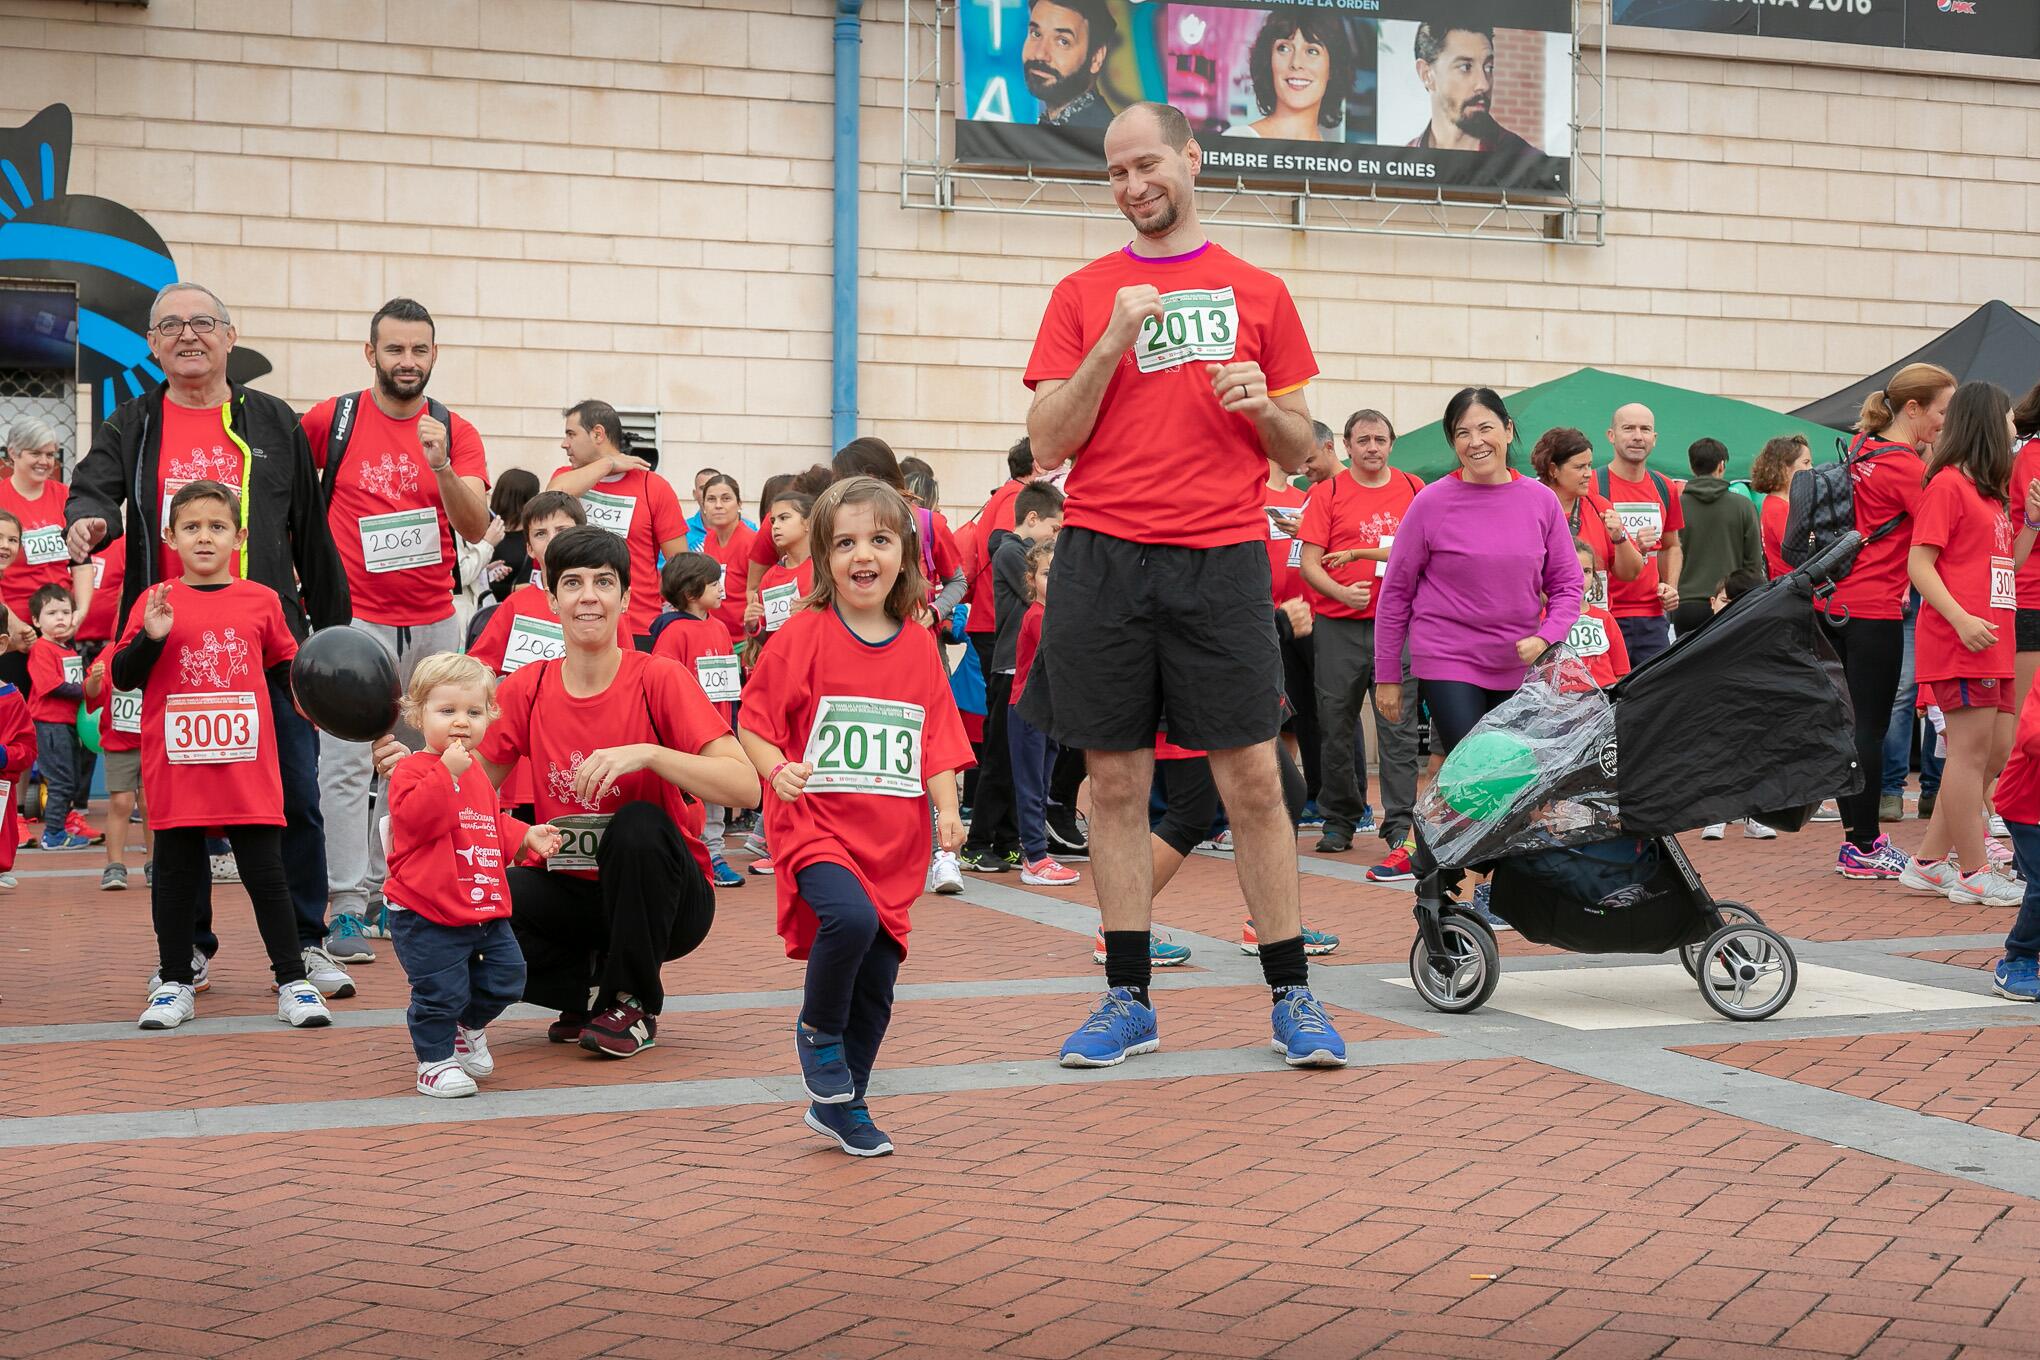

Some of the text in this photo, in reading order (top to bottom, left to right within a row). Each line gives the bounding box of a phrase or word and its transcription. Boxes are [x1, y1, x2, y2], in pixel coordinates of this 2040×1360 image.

[1317, 0, 1334, 8] LA
[1337, 0, 1379, 11] ORDEN
[1203, 151, 1436, 178] IEMBRE ESTRENO EN CINES
[1144, 309, 1230, 352] 2013
[336, 398, 353, 440] HEAD
[585, 503, 622, 522] 2067
[1622, 516, 1652, 527] 2064
[28, 535, 64, 554] 2055
[369, 528, 423, 553] 2068
[771, 600, 789, 615] 20
[1569, 626, 1602, 648] 036
[113, 697, 142, 719] 204
[175, 713, 250, 748] 3003
[818, 724, 913, 775] 2013
[558, 829, 598, 857] 20
